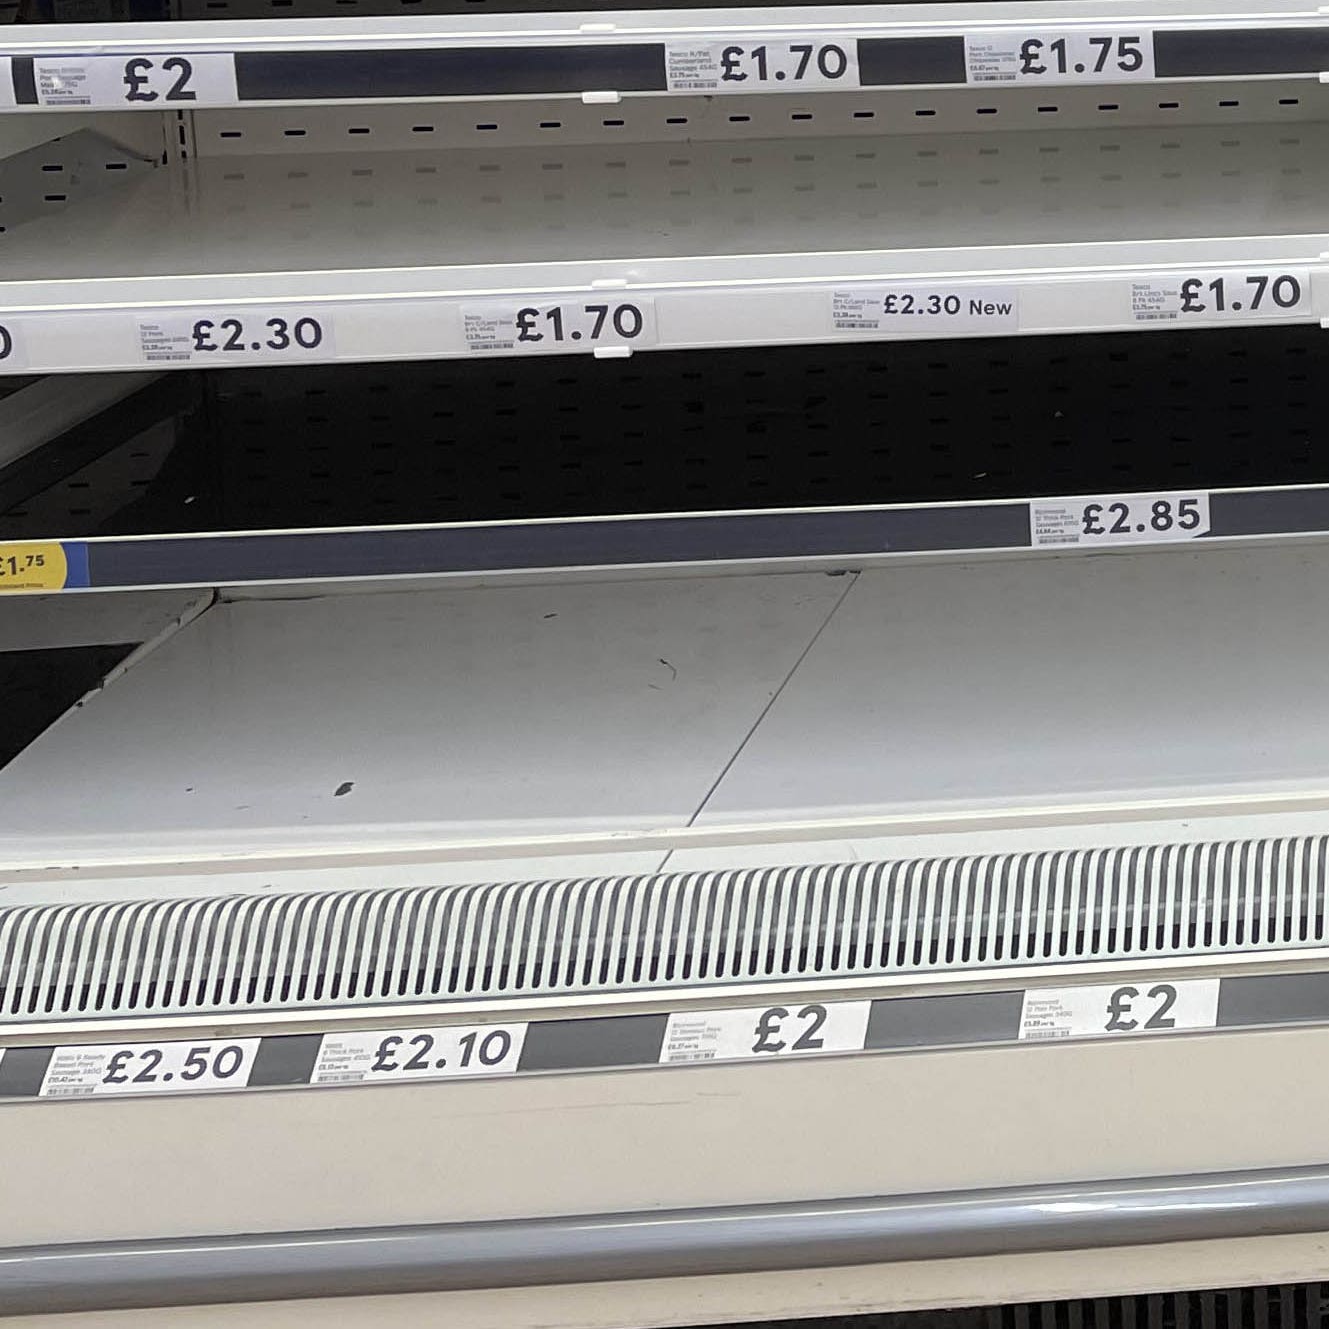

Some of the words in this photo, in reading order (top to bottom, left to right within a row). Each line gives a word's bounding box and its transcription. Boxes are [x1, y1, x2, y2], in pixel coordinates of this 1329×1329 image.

[721, 45, 847, 81] £1.70
[1020, 37, 1142, 74] £1.75
[124, 57, 196, 101] £2
[884, 295, 960, 315] £2.30
[970, 300, 1011, 315] New
[1180, 275, 1300, 312] £1.70
[192, 318, 322, 351] £2.30
[516, 304, 642, 342] £1.70
[1083, 499, 1200, 535] £2.85
[1105, 985, 1176, 1031] £2
[752, 1005, 827, 1053] £2
[103, 1046, 243, 1083] £2.50
[371, 1030, 511, 1072] £2.10
